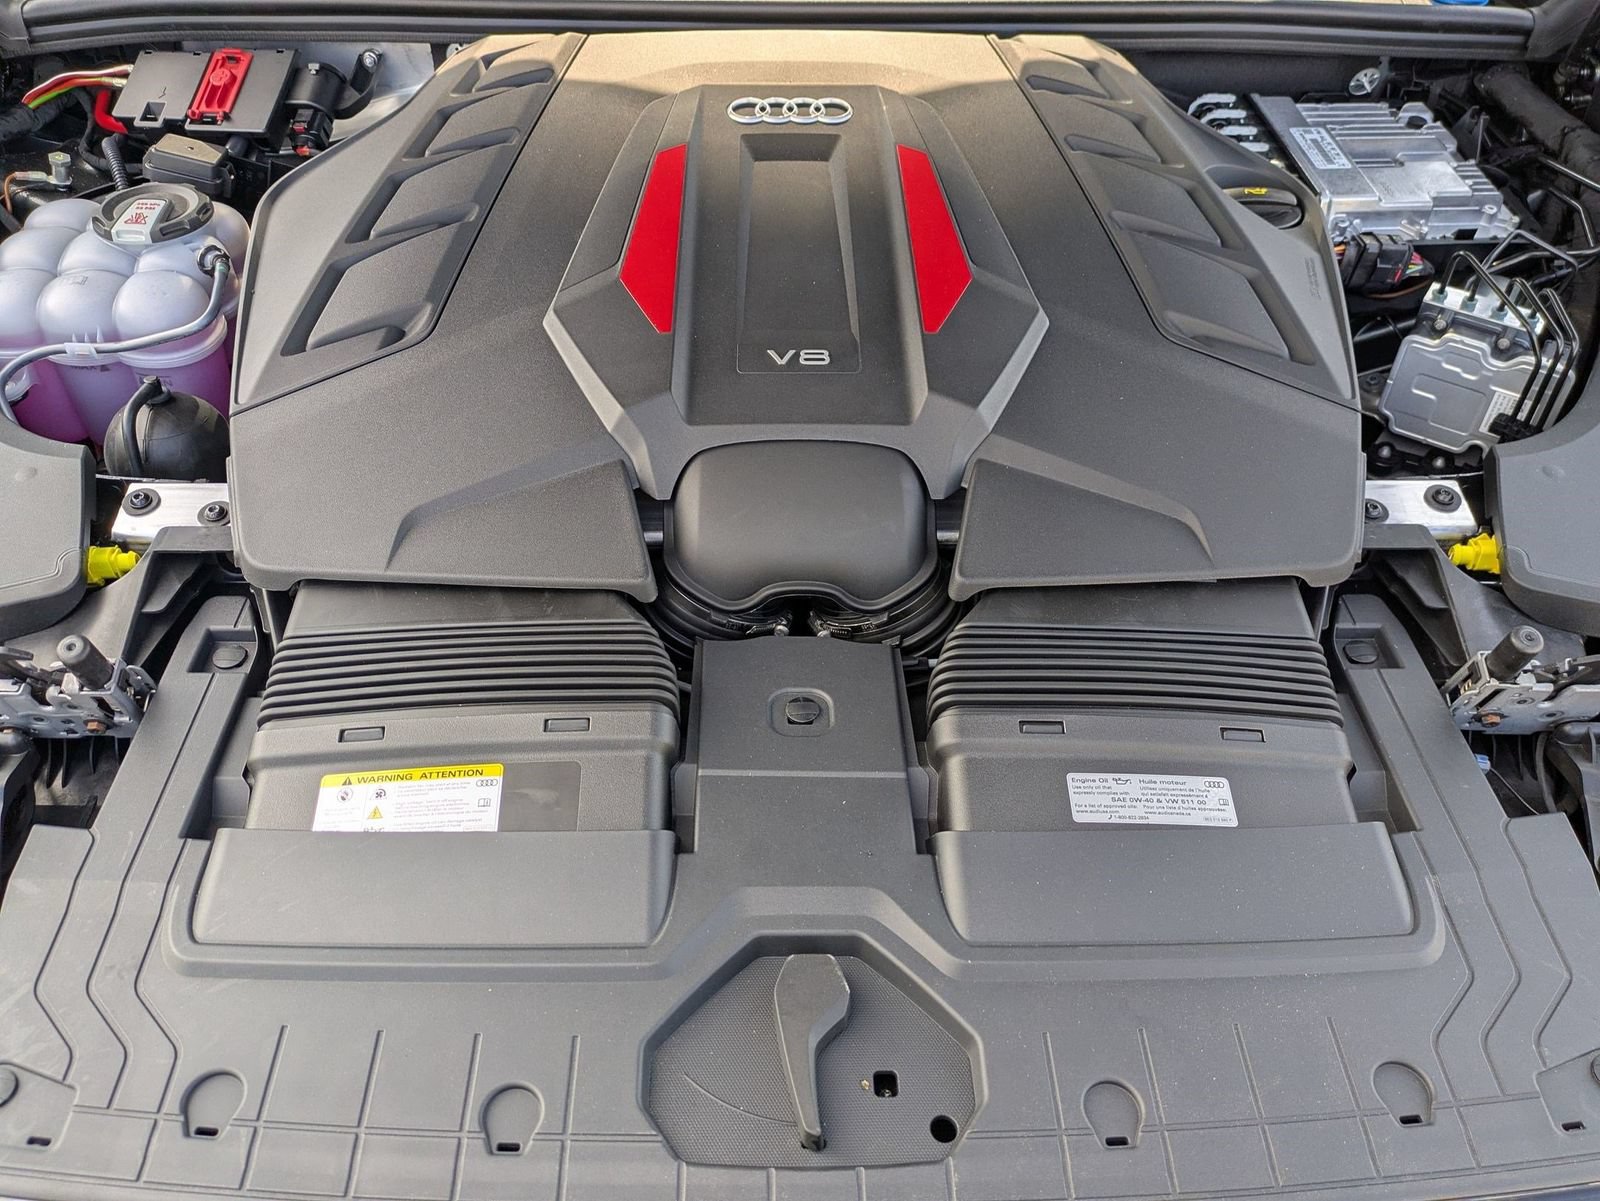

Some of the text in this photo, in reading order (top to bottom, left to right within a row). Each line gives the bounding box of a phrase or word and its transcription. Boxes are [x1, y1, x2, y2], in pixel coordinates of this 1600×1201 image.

[766, 349, 831, 365] V8
[357, 773, 413, 785] WARNING
[419, 769, 484, 779] ATTENTION
